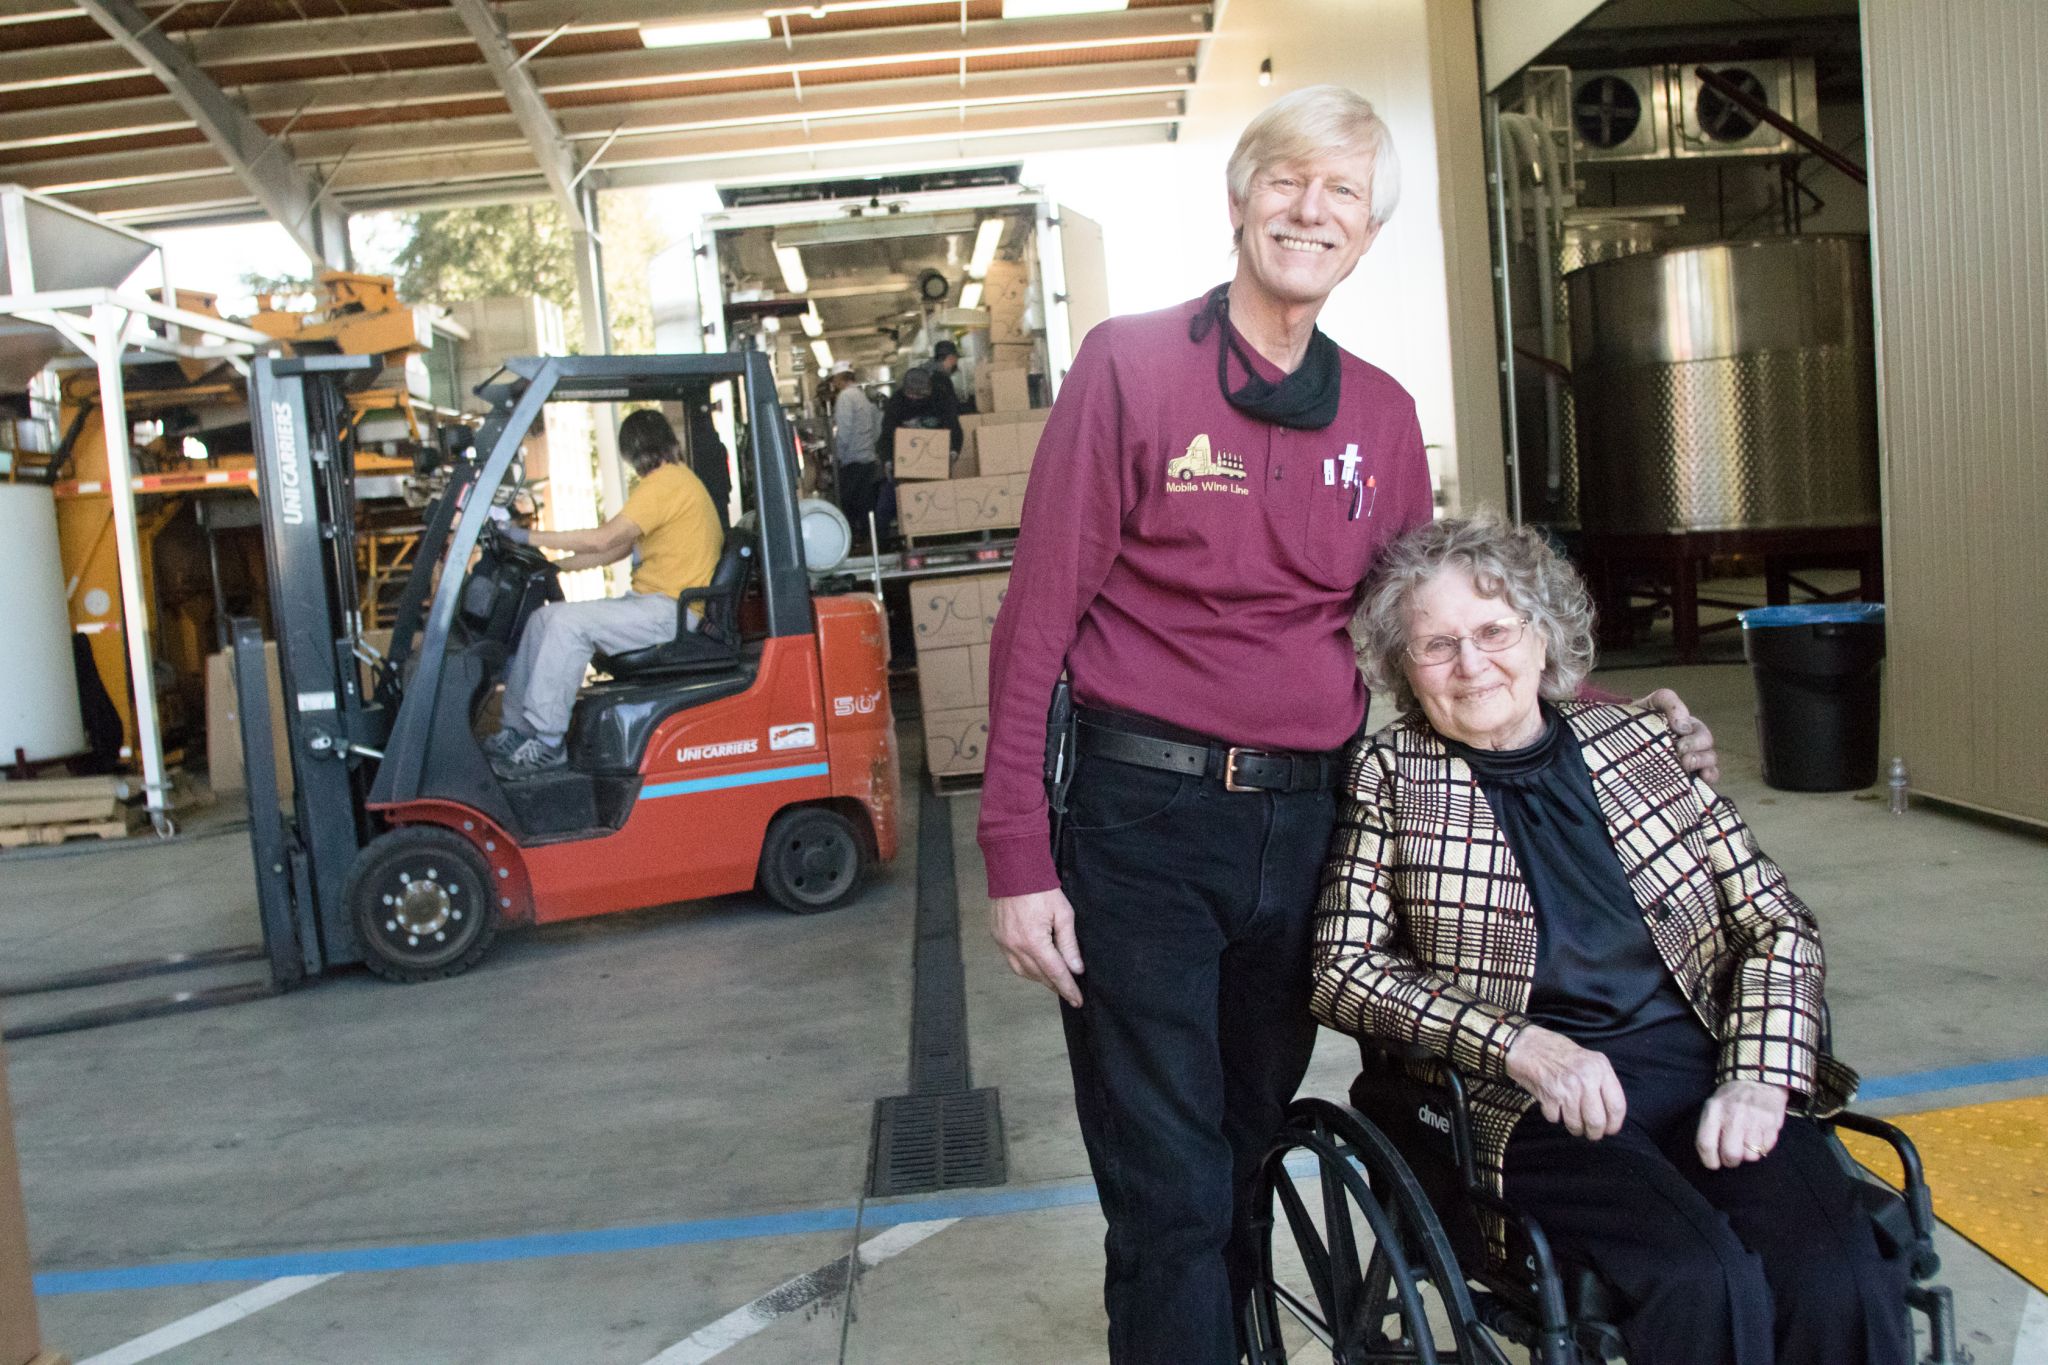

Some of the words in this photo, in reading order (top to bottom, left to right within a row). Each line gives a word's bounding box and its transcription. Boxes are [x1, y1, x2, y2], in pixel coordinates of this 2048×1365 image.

[272, 402, 303, 524] UNICARRIERS
[1166, 482, 1198, 492] Mobile
[1201, 482, 1228, 492] Wine
[1231, 484, 1249, 496] Line
[1418, 1104, 1450, 1133] drive
